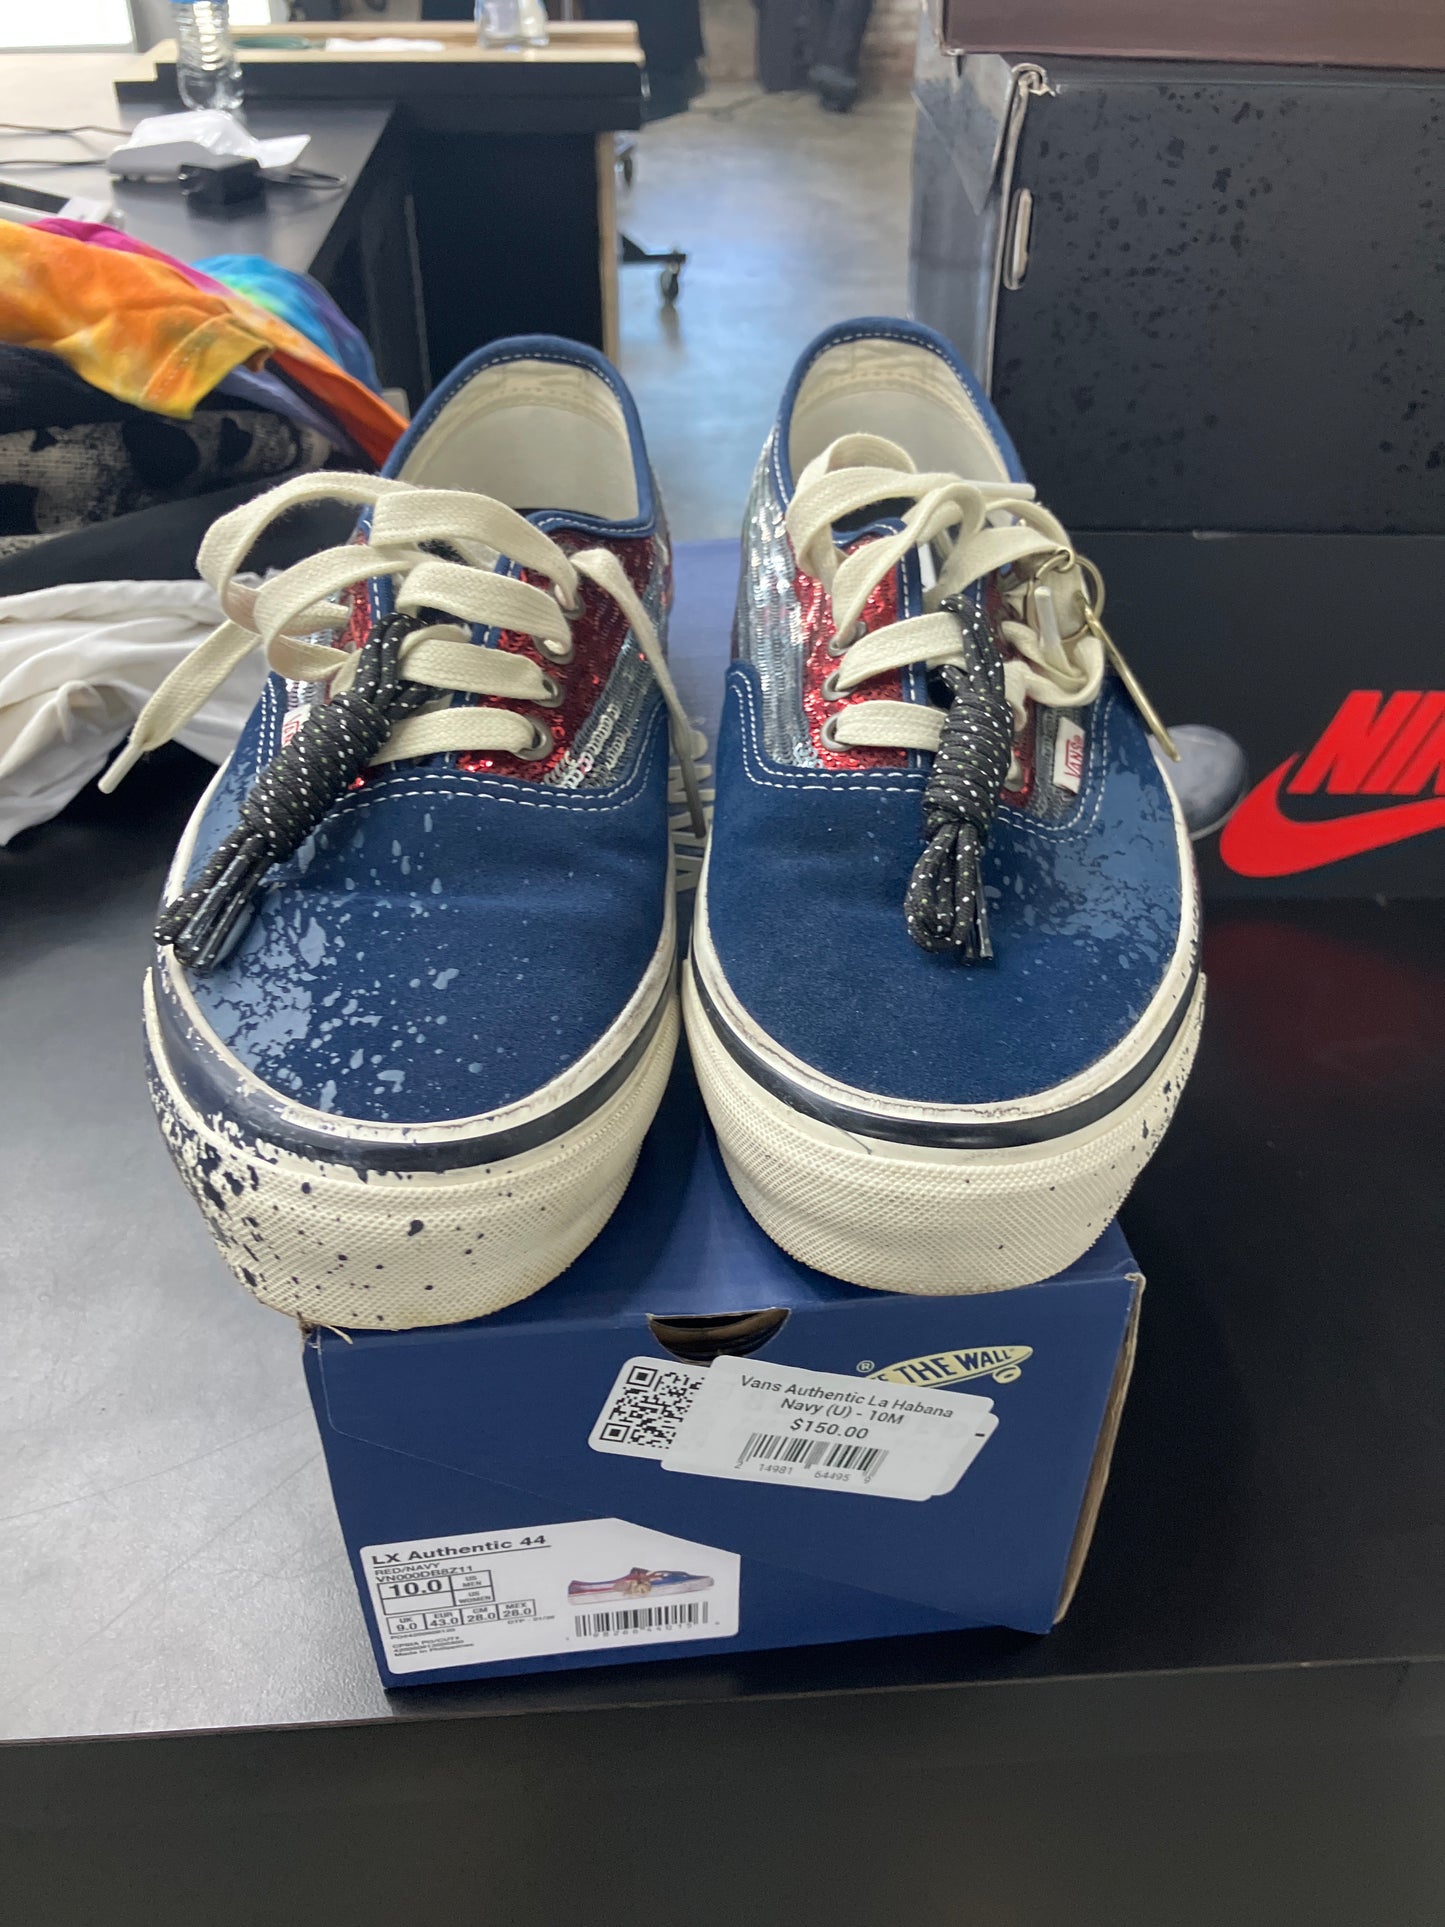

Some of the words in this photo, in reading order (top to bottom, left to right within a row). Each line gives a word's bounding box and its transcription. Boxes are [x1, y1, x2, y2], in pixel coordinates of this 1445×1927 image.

[893, 1357, 958, 1384] THE
[953, 1350, 1012, 1372] WALL
[741, 1375, 782, 1392] Vans
[784, 1384, 865, 1404] Authentic
[868, 1395, 889, 1409] La
[891, 1399, 954, 1418] Habana
[780, 1398, 824, 1416] Navy
[826, 1403, 853, 1419] (U)
[868, 1410, 904, 1425] 10M
[790, 1418, 869, 1440] $150.00
[758, 1462, 793, 1475] 14981
[372, 1553, 401, 1565] LX
[408, 1541, 512, 1561] Authentic
[519, 1535, 547, 1546] 44
[374, 1562, 440, 1576] RED/NAVY
[389, 1579, 442, 1597] 10.0
[458, 1595, 491, 1604] WOMEN
[505, 1602, 527, 1610] MEX
[466, 1612, 496, 1623] 28.0
[502, 1608, 532, 1618] 28.0
[396, 1622, 418, 1632] 9.0
[430, 1617, 459, 1627] 43.0
